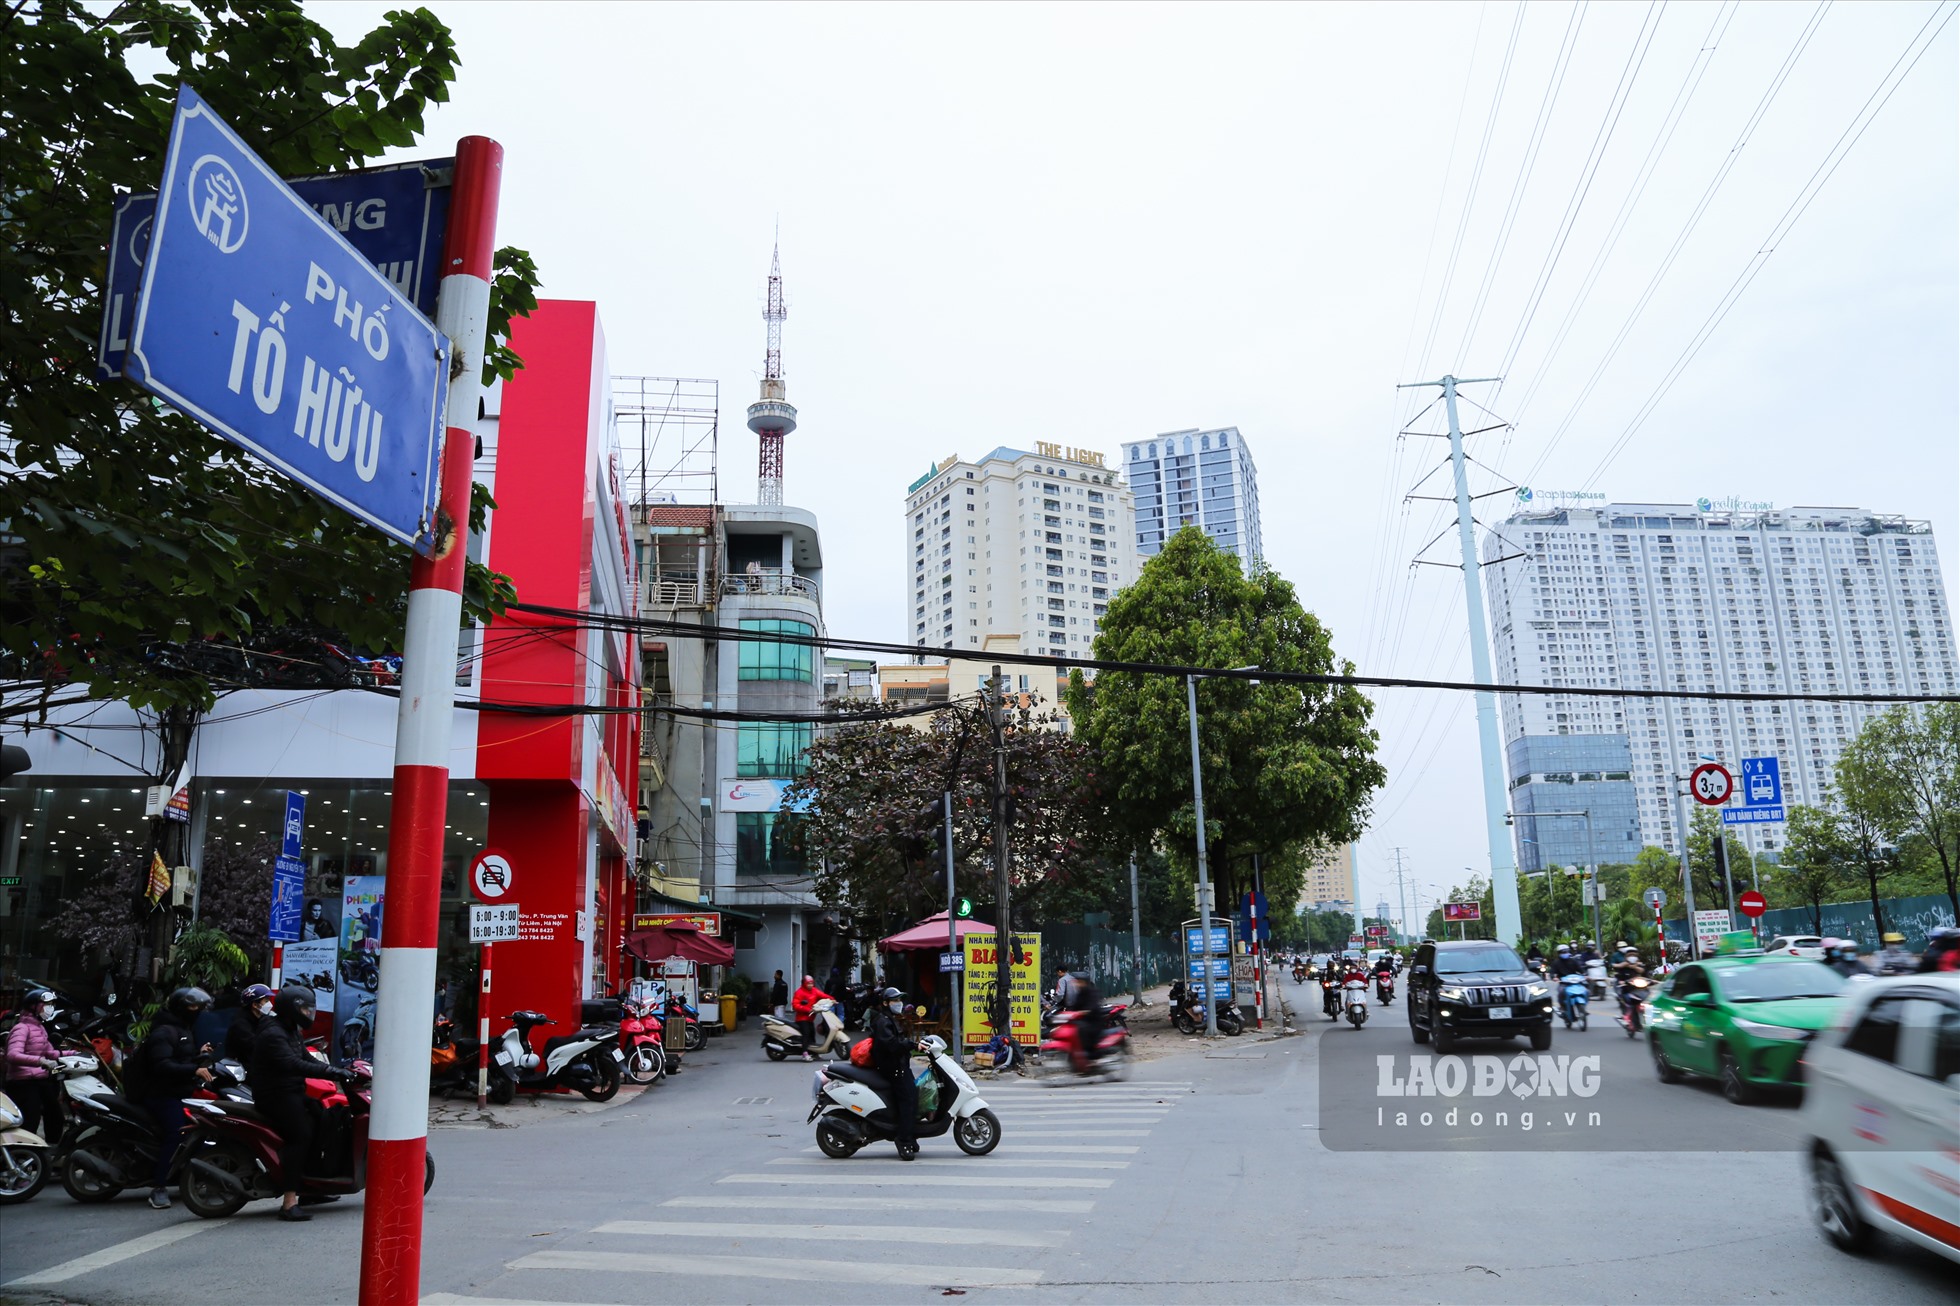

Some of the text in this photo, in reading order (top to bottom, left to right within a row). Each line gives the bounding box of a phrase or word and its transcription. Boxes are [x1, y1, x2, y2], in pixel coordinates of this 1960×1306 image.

[305, 261, 390, 361] PHỐ
[227, 299, 291, 415] TỐ
[294, 356, 383, 483] HỮU
[1036, 440, 1104, 467] THE LIGHT
[1724, 809, 1737, 822] LÀN
[1, 877, 20, 885] EXIT
[476, 910, 491, 922] 6:00
[500, 910, 516, 921] 9:00
[968, 936, 983, 945] NHÀ
[951, 955, 963, 965] 385
[971, 948, 998, 964] BIA
[981, 970, 985, 979] 2
